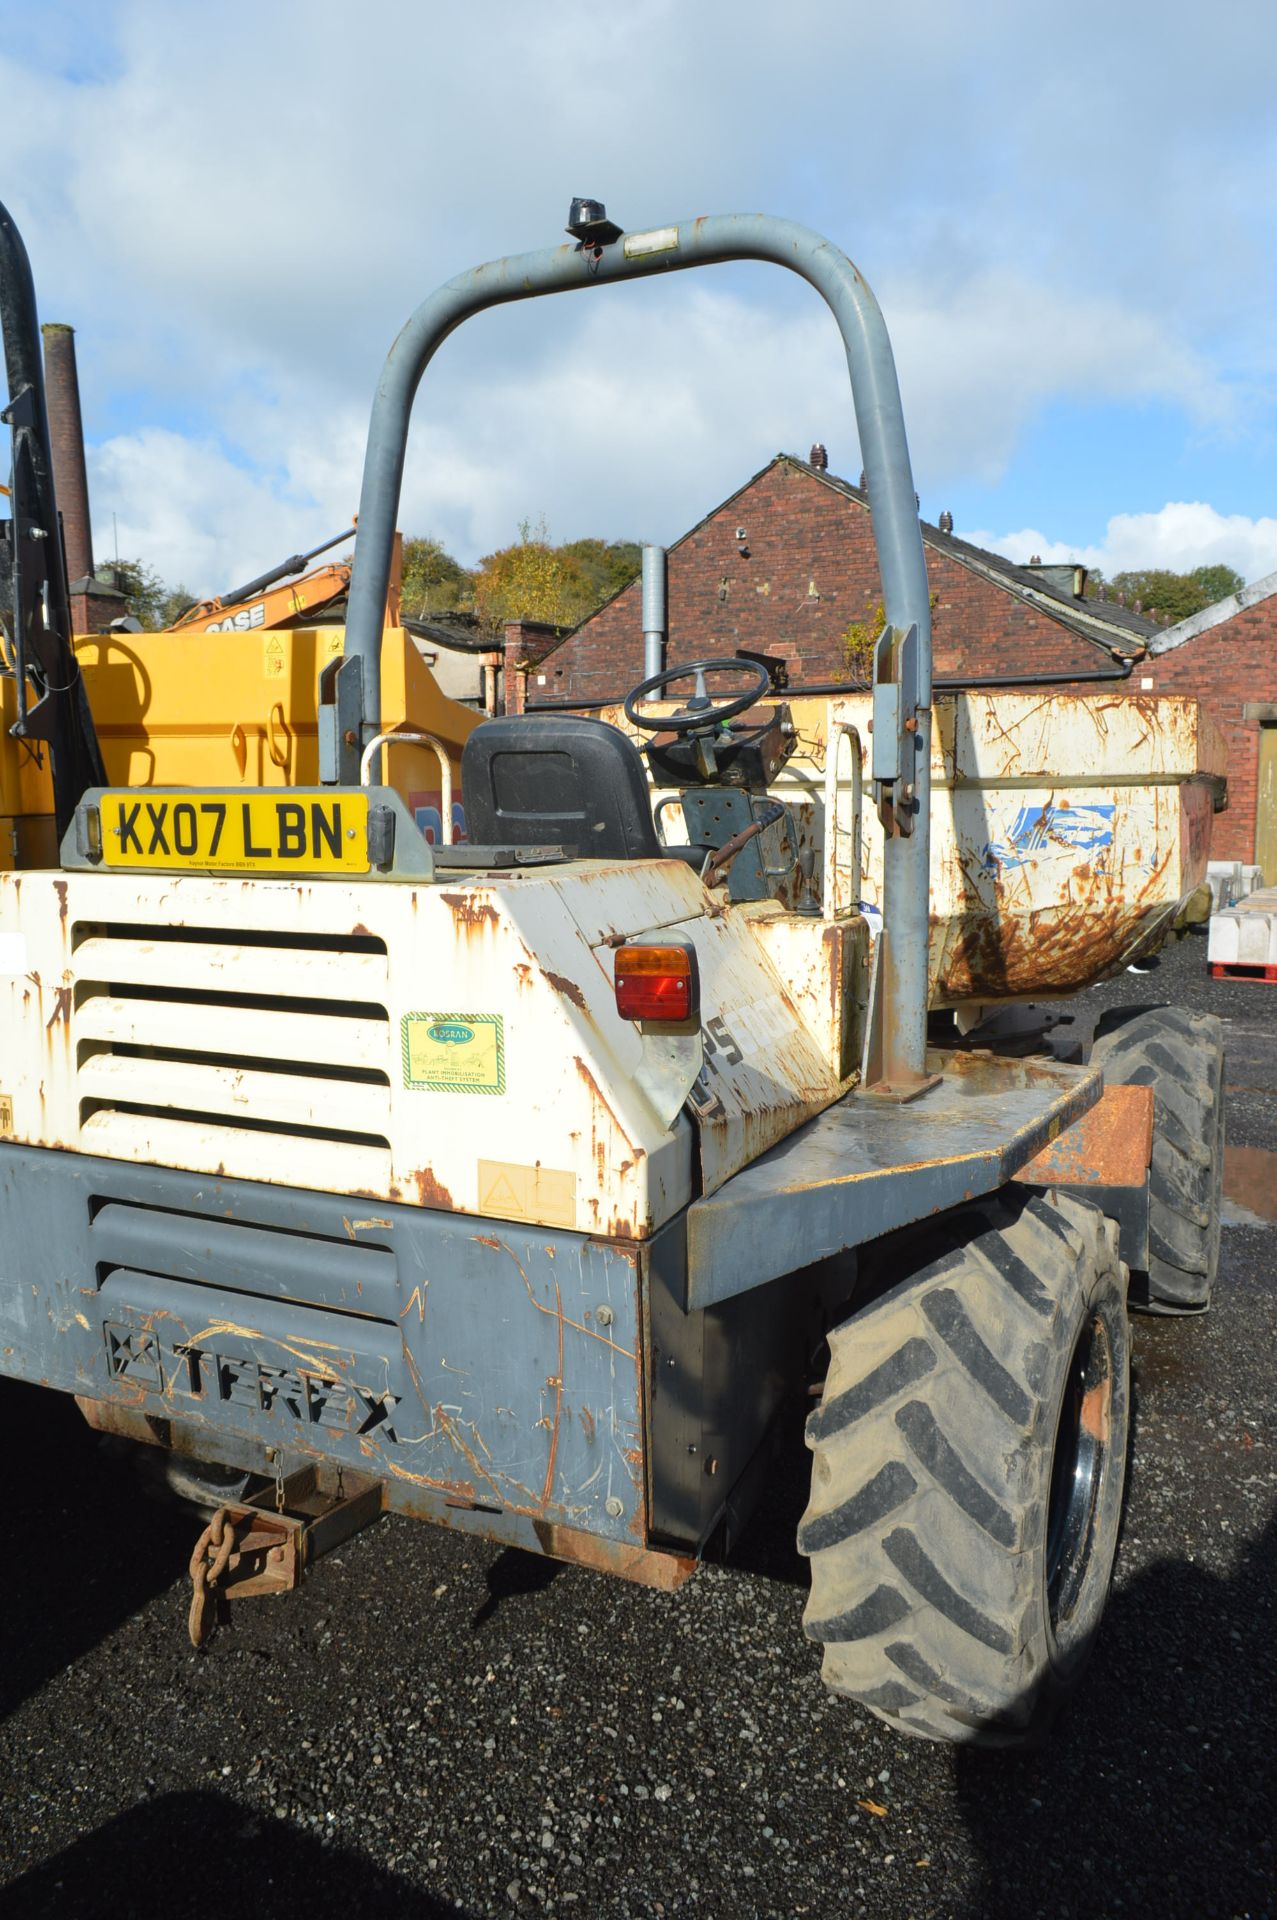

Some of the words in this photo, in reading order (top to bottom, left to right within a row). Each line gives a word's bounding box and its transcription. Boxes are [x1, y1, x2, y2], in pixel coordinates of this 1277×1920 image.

[119, 803, 226, 857] KX07
[242, 803, 342, 859] LBN
[172, 1344, 402, 1444] TEREX
